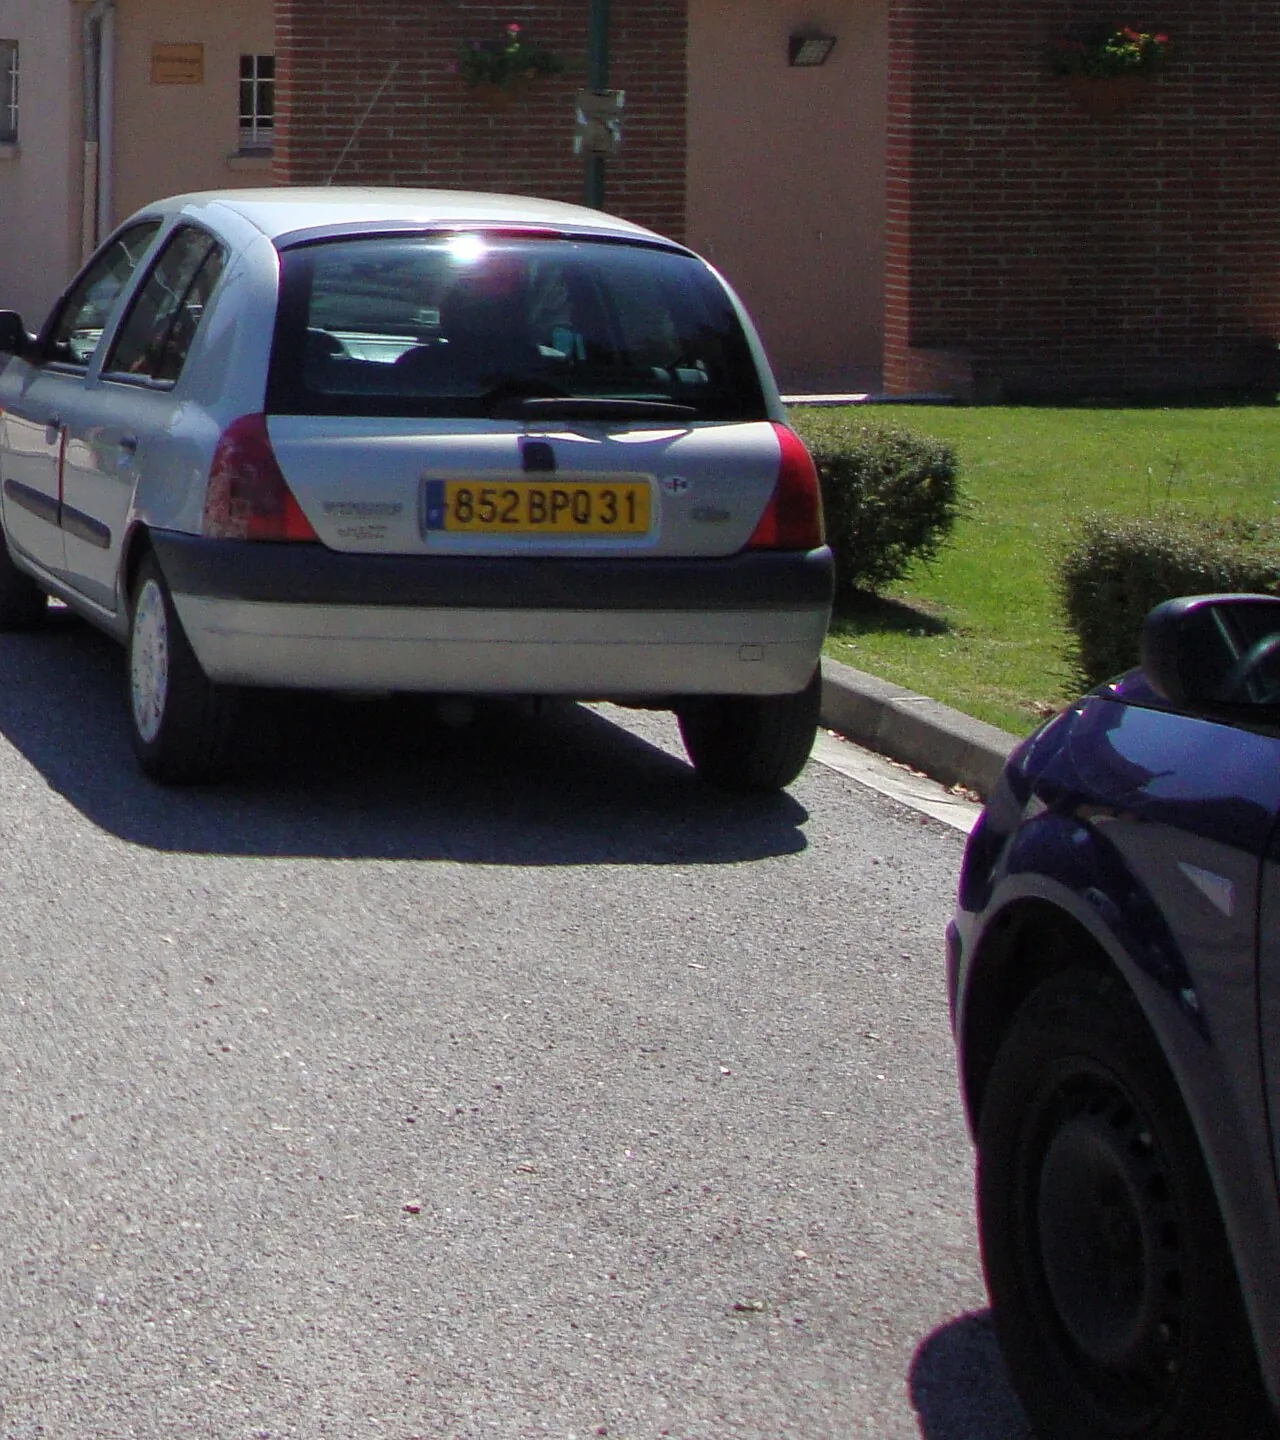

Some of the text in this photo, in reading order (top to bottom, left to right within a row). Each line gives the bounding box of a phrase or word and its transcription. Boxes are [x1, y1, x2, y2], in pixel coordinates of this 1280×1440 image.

[455, 488, 636, 525] 852 BPQ 31
